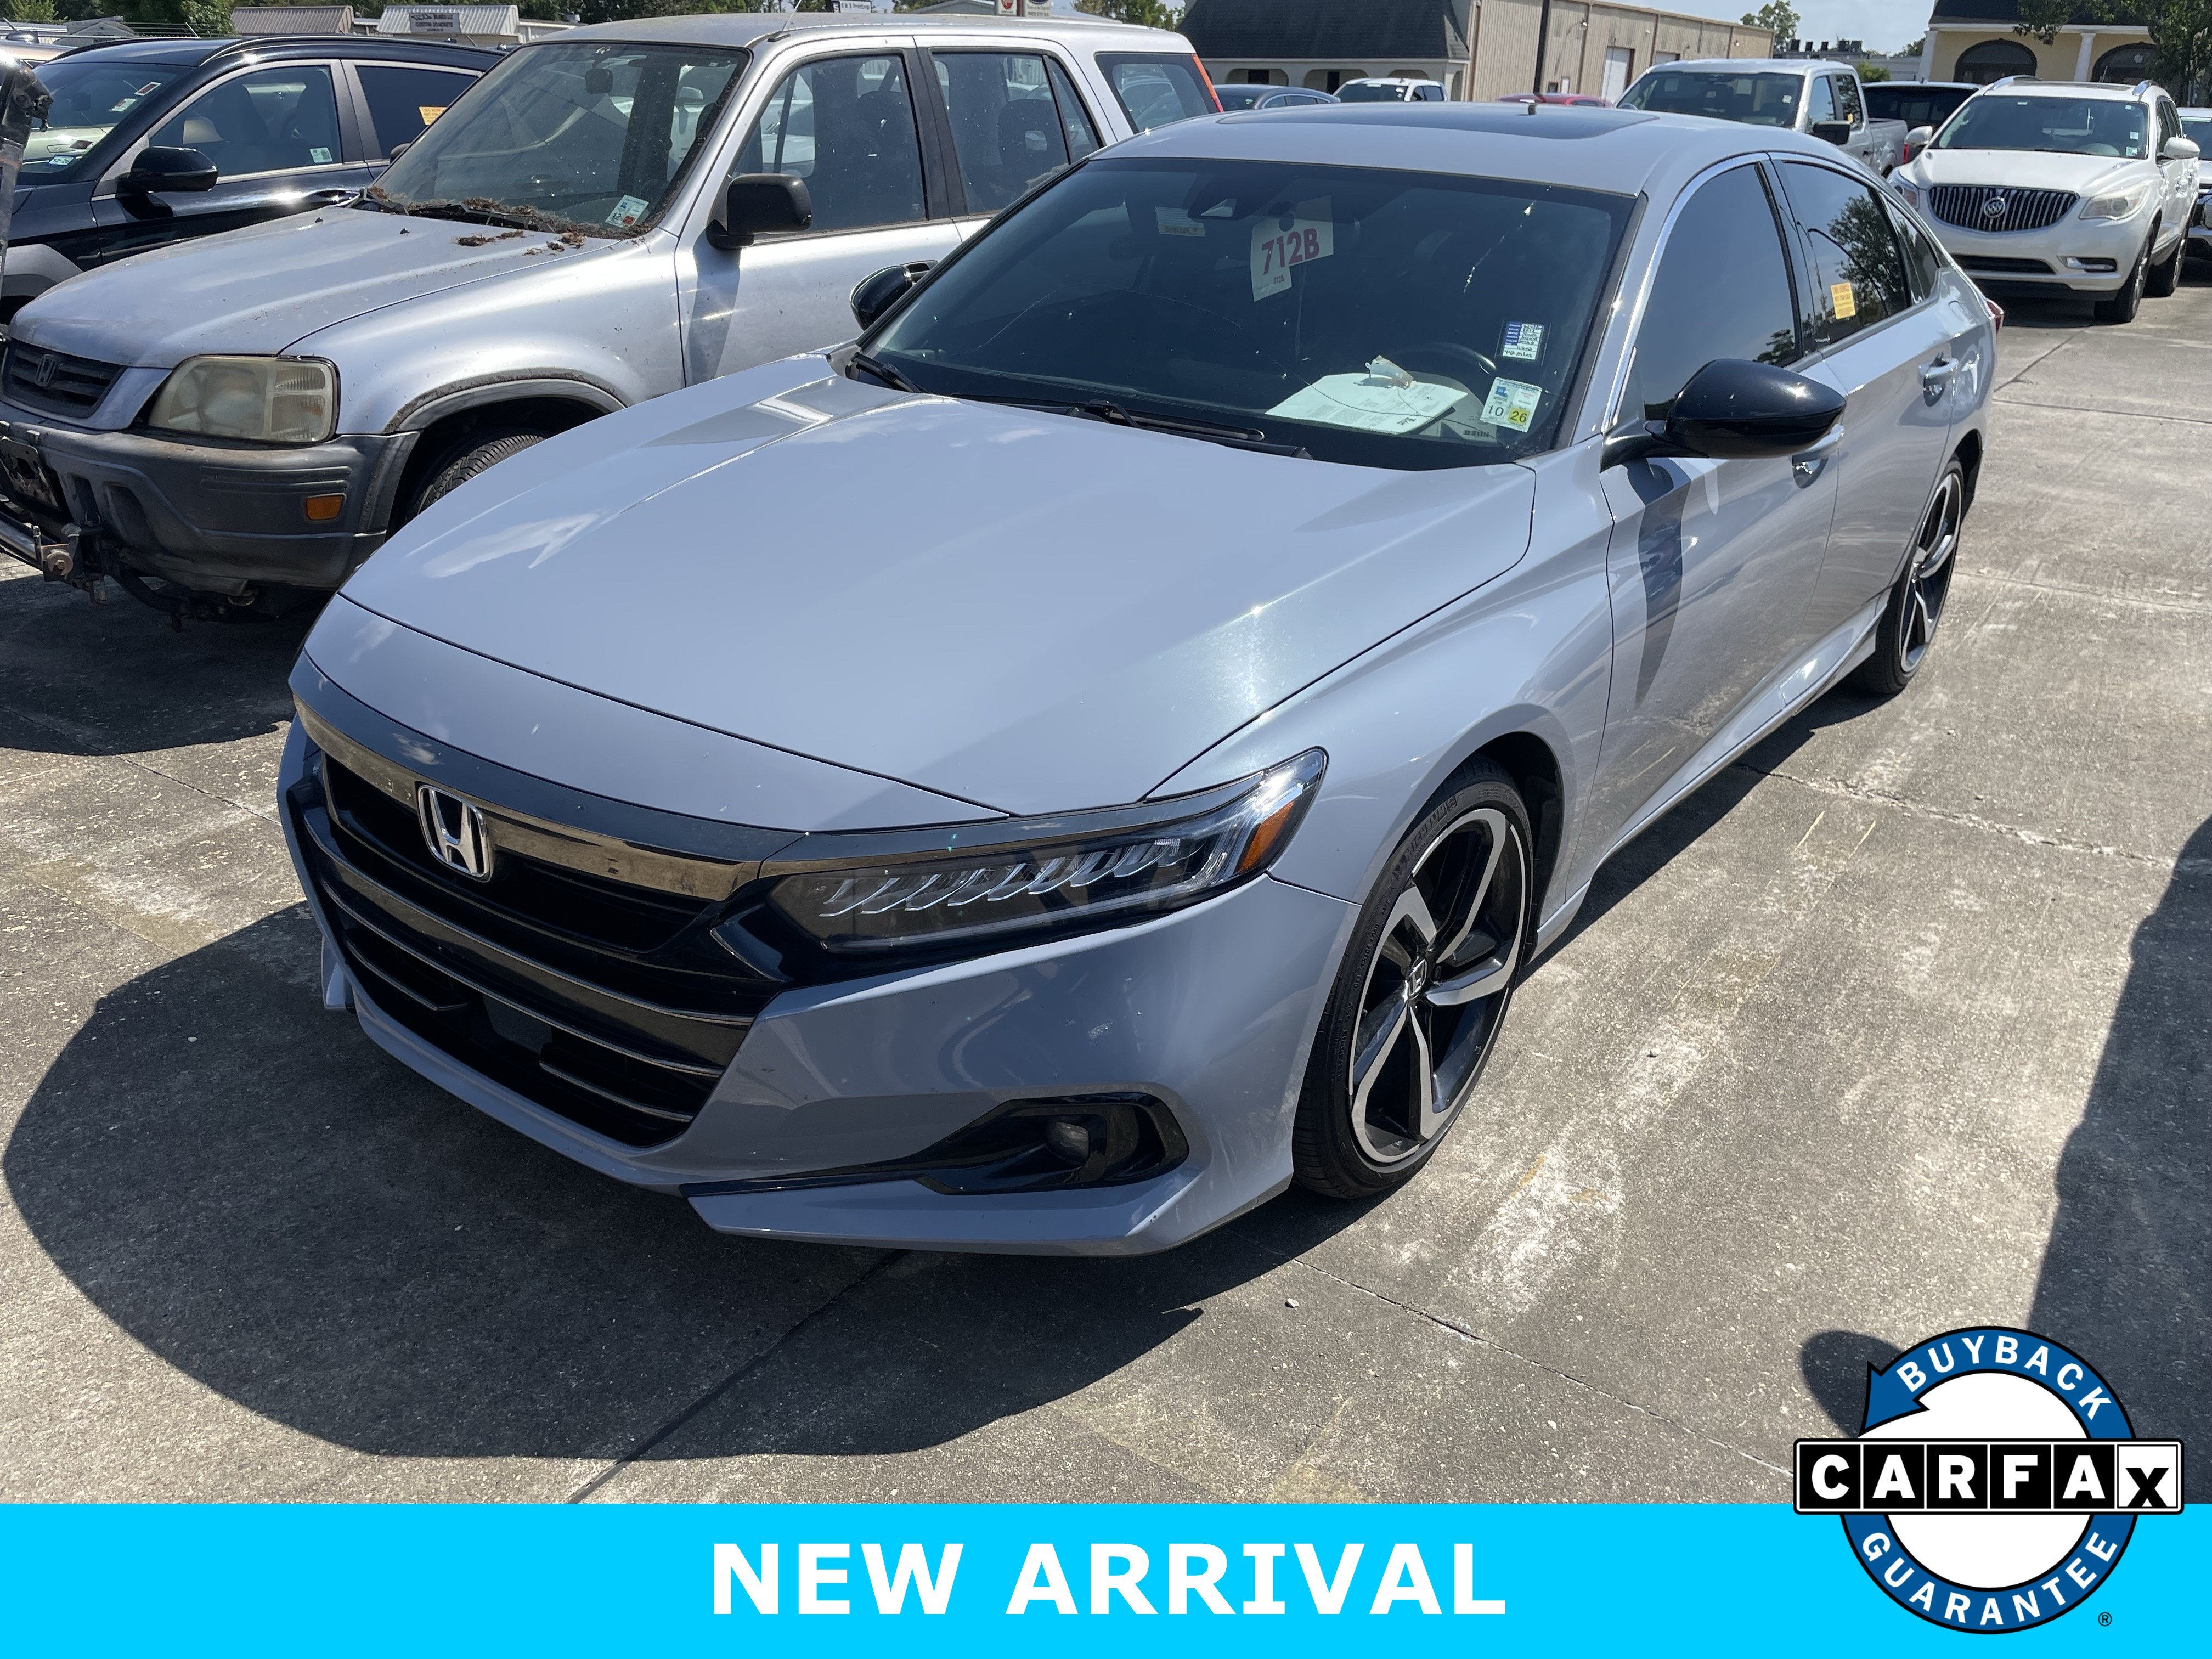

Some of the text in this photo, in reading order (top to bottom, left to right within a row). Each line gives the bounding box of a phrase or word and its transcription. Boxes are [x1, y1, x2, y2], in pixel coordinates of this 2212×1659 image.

[1262, 227, 1319, 275] 712B
[1274, 275, 1284, 284] 712B
[1489, 405, 1527, 423] 10 26
[1403, 802, 1447, 861] MICHELIN
